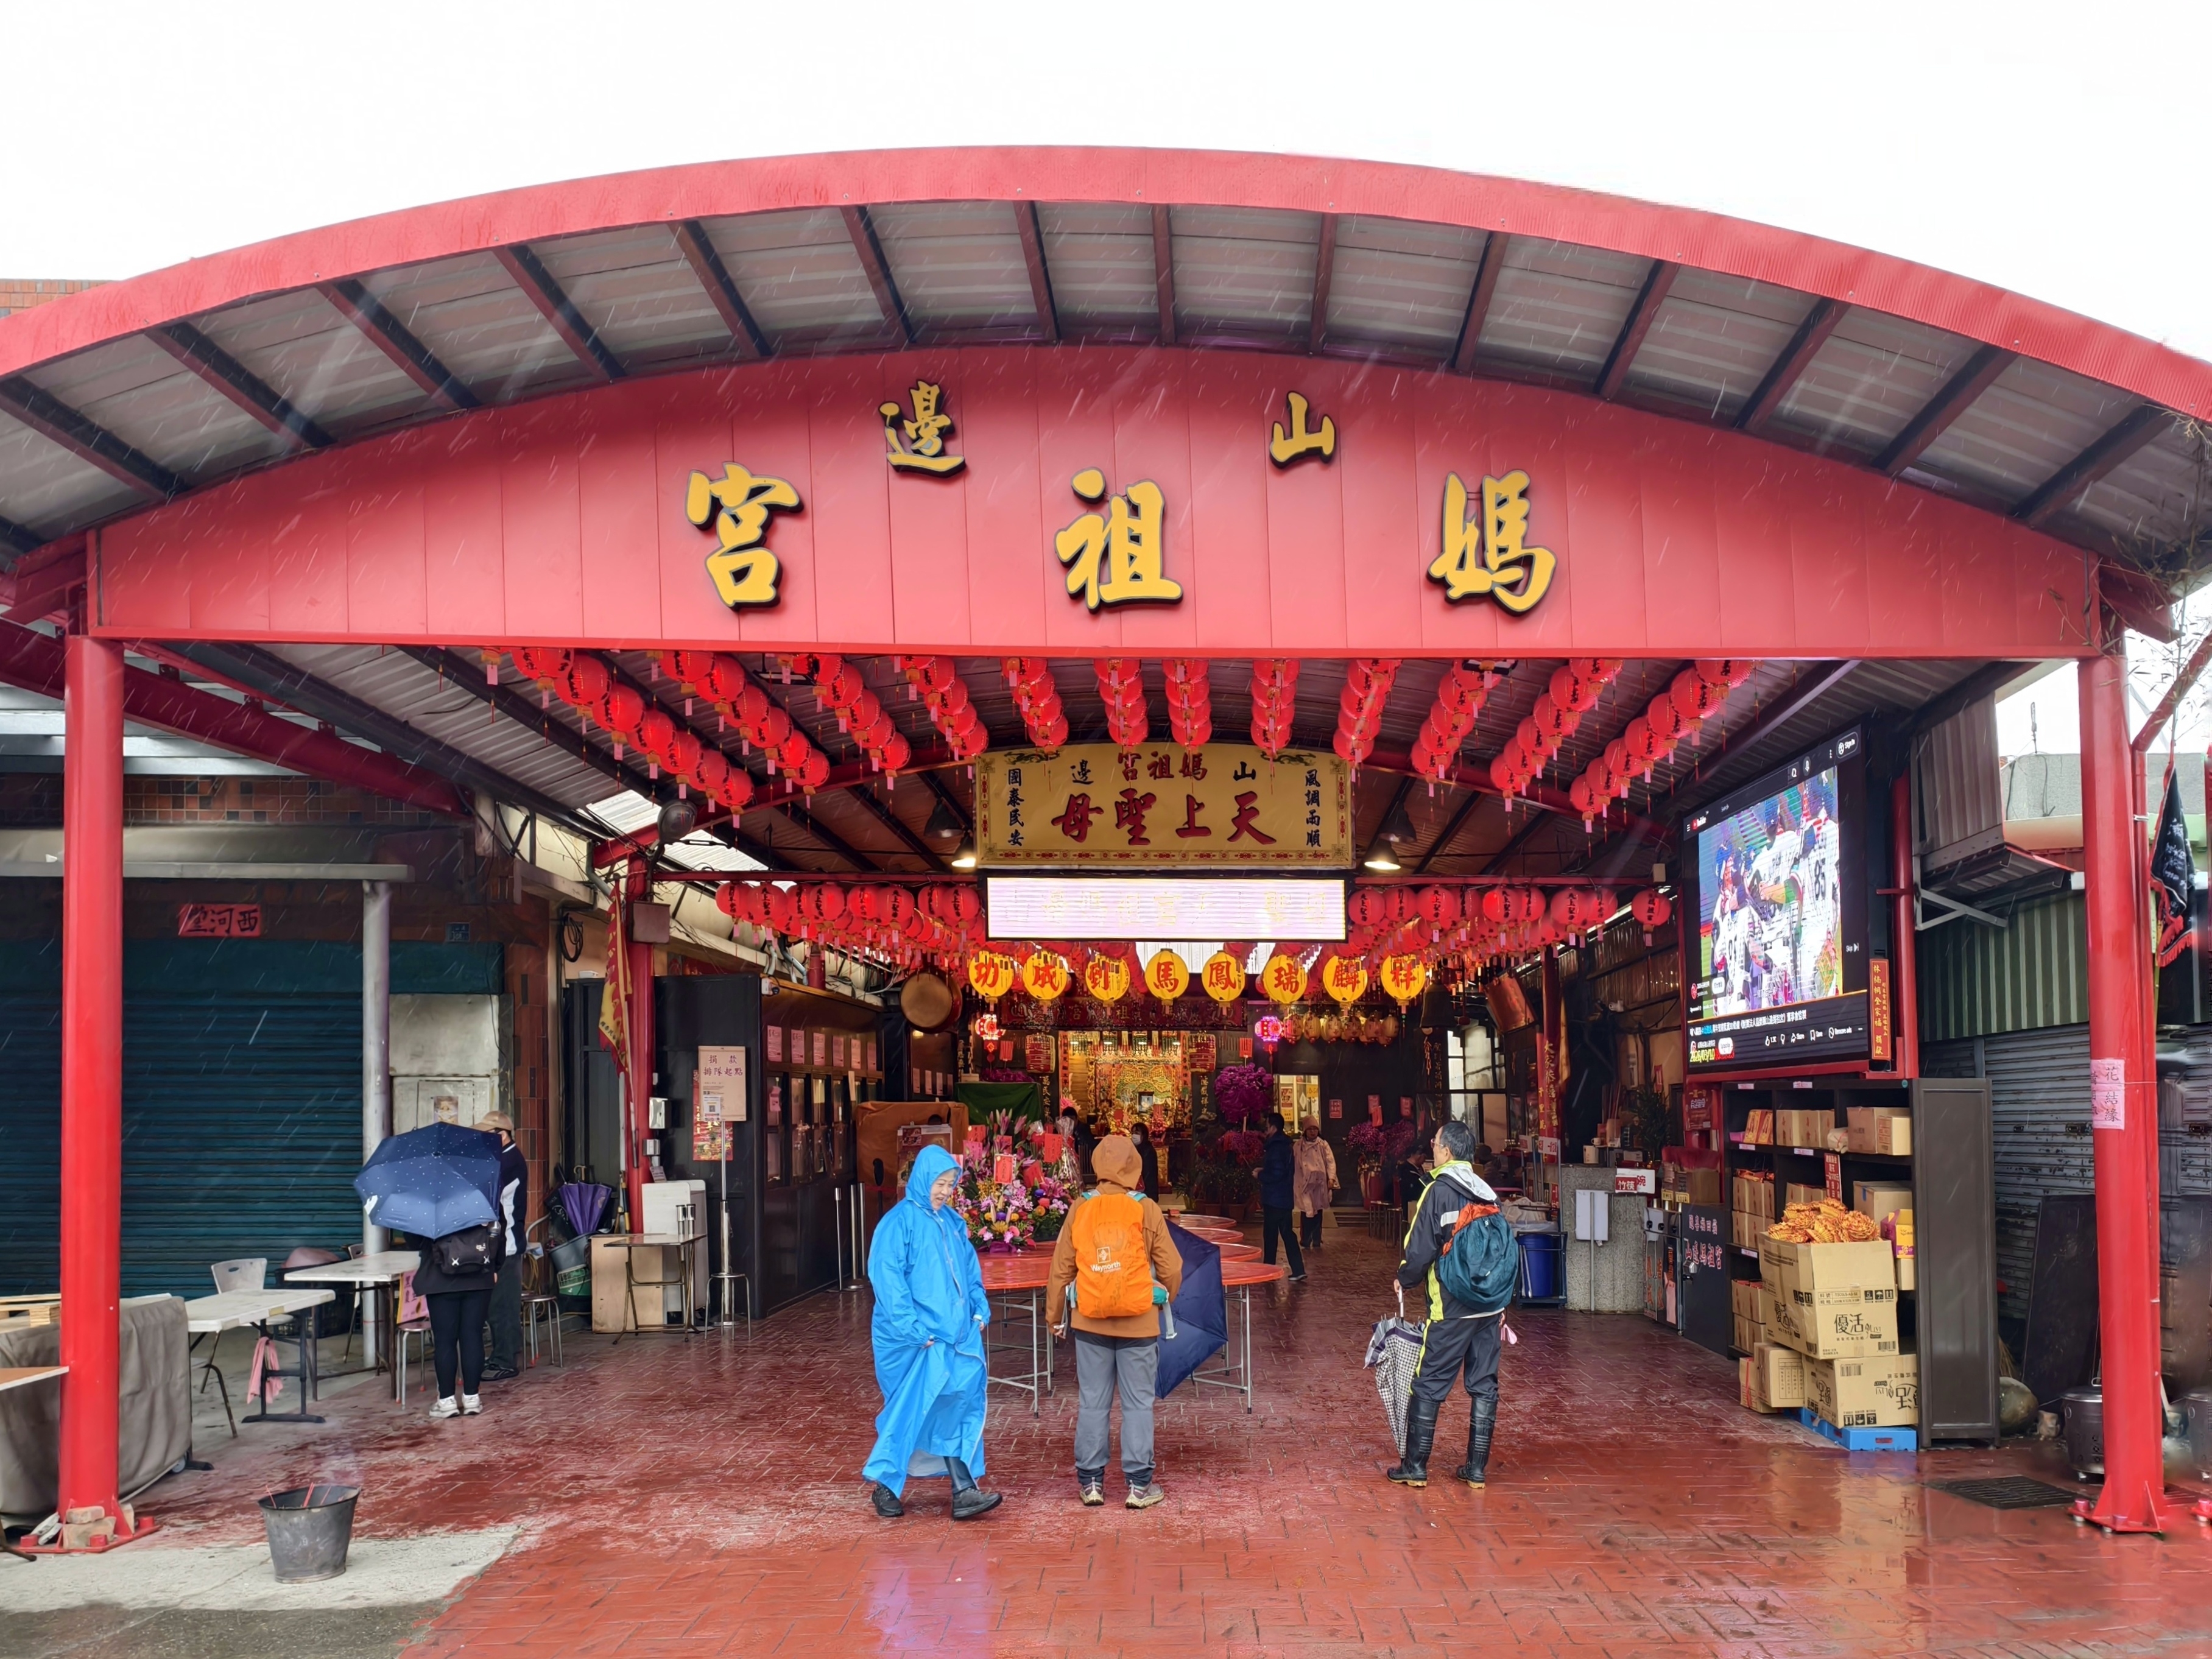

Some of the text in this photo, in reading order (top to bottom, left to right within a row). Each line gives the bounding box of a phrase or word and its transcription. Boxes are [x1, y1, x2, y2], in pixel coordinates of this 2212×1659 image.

[686, 460, 1557, 616] 媽祖宮
[1007, 768, 1024, 847] 國泰民安
[1051, 787, 1277, 845] 天上聖母
[1305, 769, 1321, 847] 風調雨順
[186, 906, 258, 934] 西河堂
[975, 958, 999, 988] 功
[1032, 963, 1060, 992] 成
[1154, 961, 1179, 993] 馬
[1209, 960, 1236, 990] 鳳
[1274, 963, 1300, 994] 瑞
[1391, 958, 1417, 991] 祥
[703, 1067, 744, 1076] 排隊起點
[709, 1055, 738, 1064] 捐款
[2105, 1066, 2121, 1122] 花結緣
[1618, 1180, 1635, 1191] 竹筷
[1090, 1261, 1121, 1272] Waynorth
[1834, 1313, 1864, 1334] 優活
